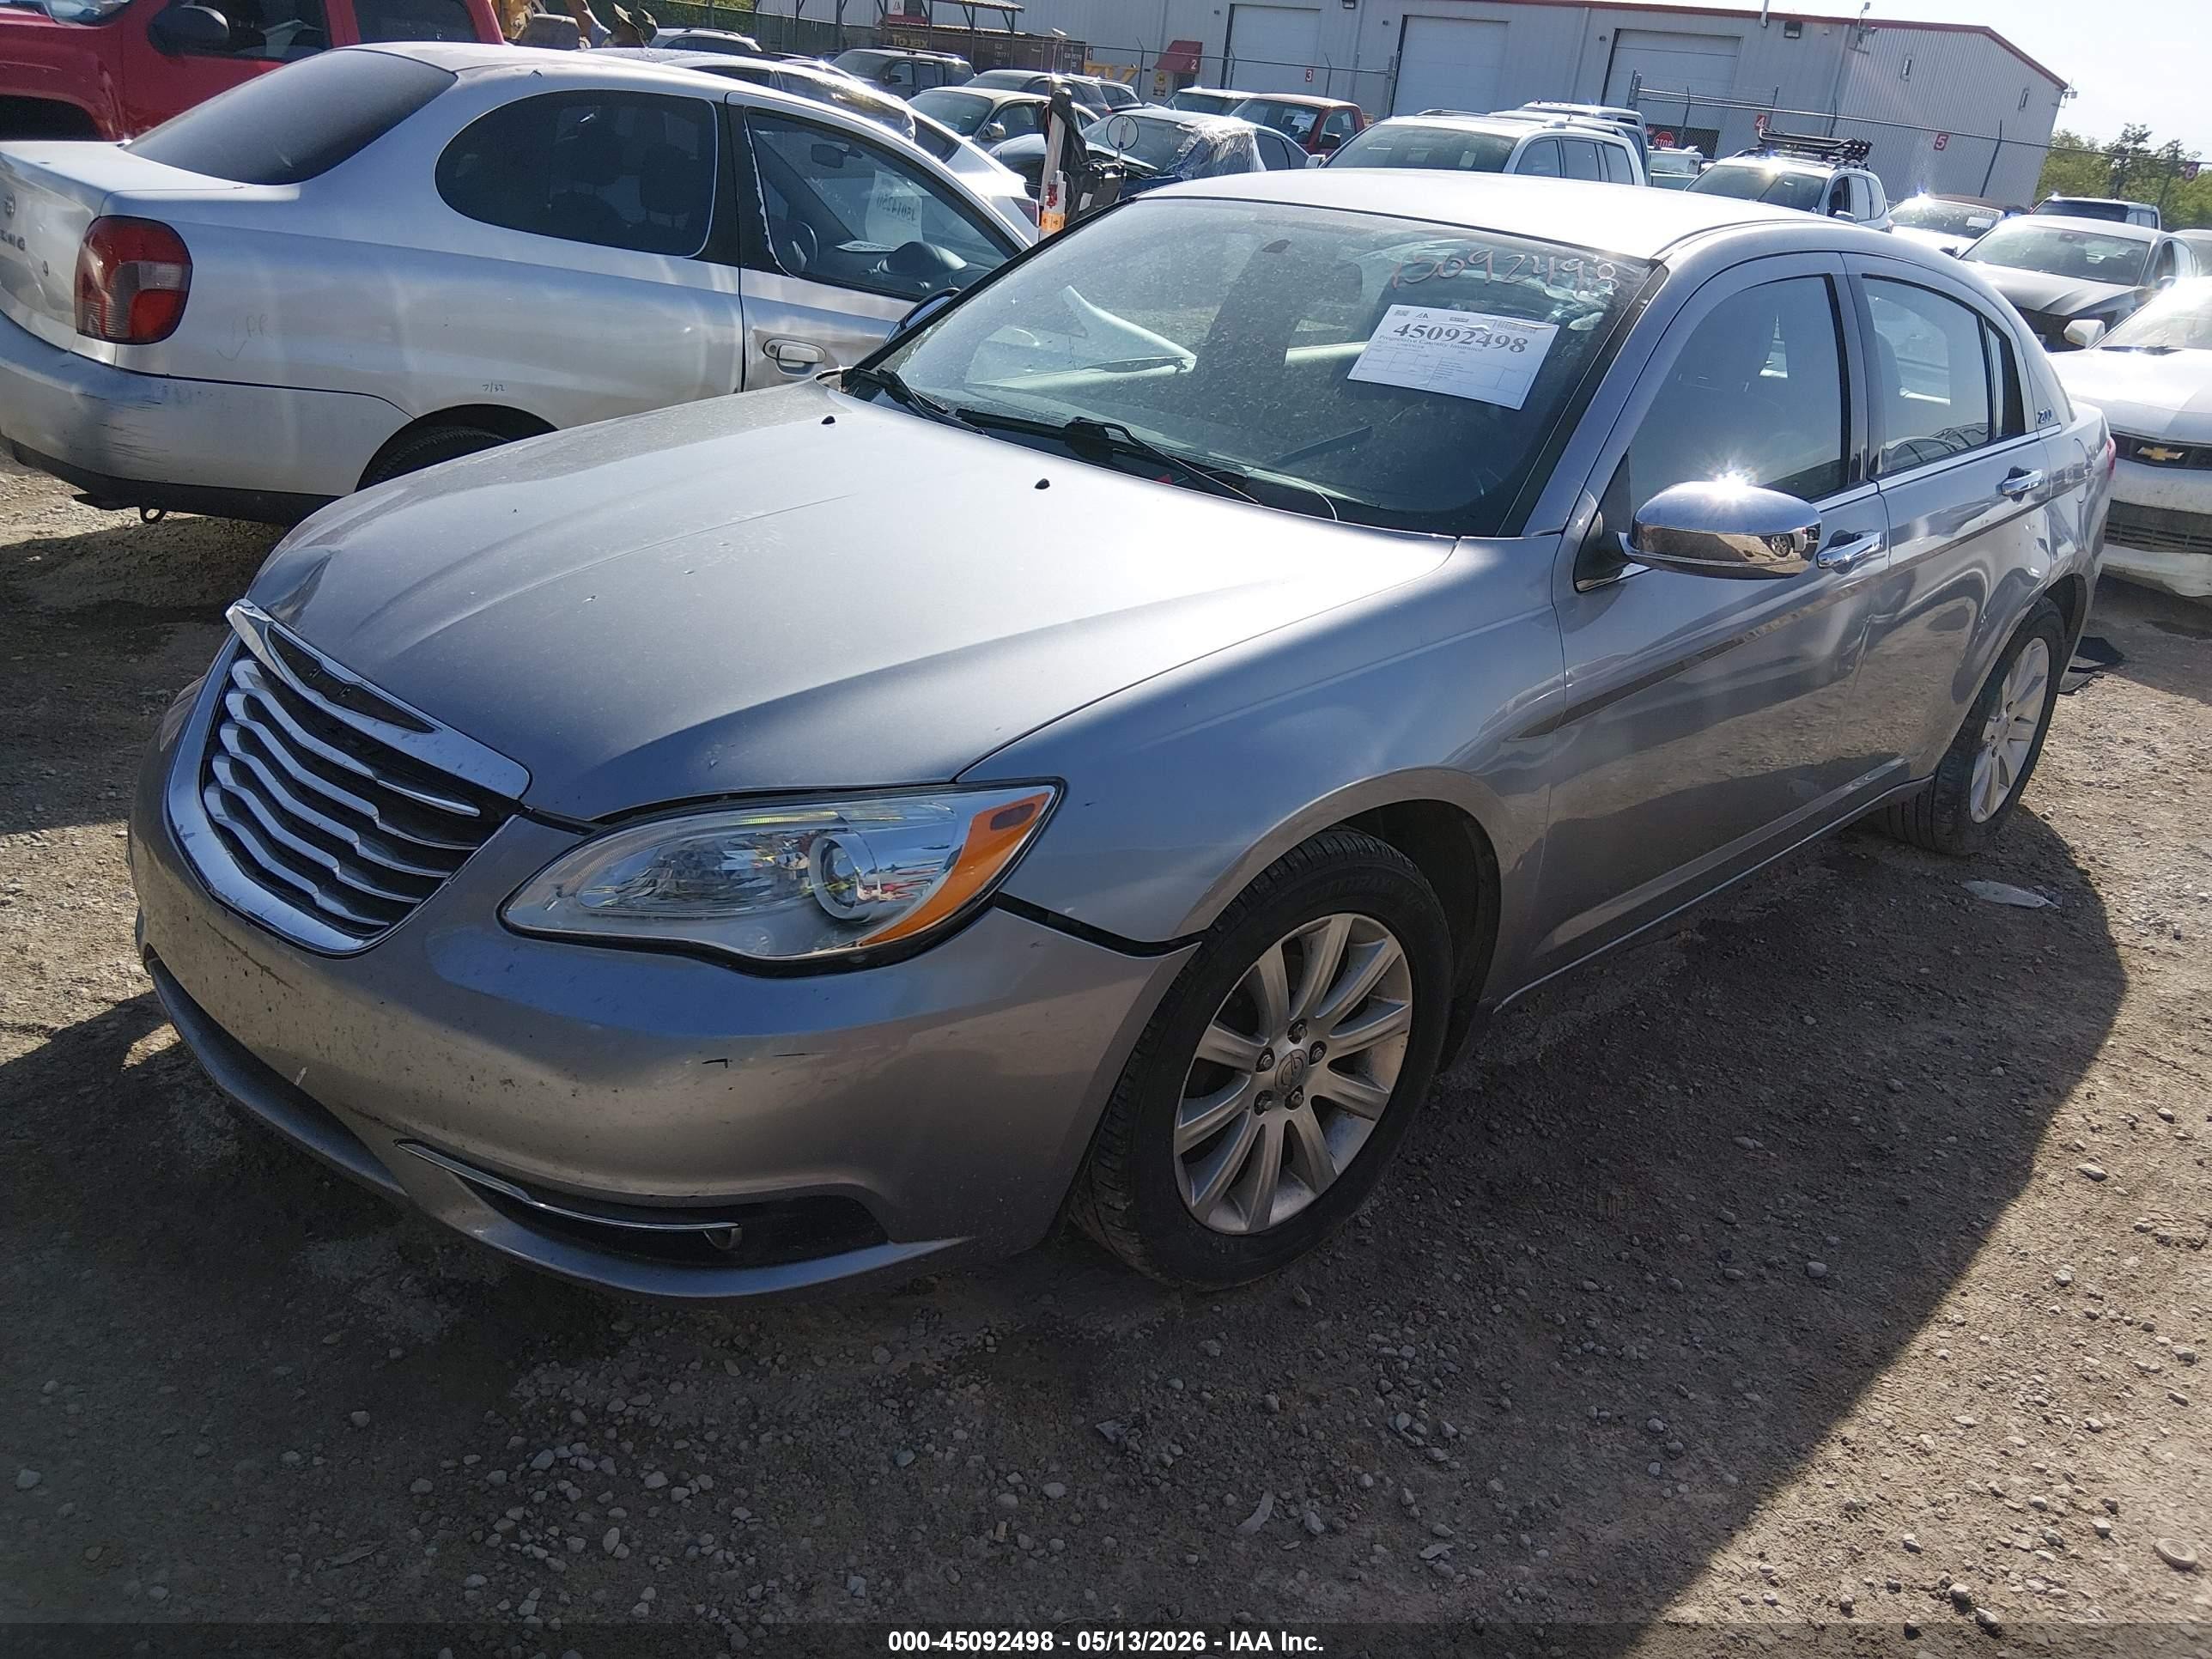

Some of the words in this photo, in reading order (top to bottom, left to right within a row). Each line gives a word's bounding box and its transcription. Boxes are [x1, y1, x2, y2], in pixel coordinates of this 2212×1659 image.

[1190, 59, 1197, 70] 2
[1305, 70, 1313, 82] 3
[1756, 117, 1765, 129] 4
[1656, 138, 1674, 147] STOP
[1936, 136, 1948, 149] 5
[2185, 165, 2197, 179] 6
[1393, 323, 1528, 353] 45092498
